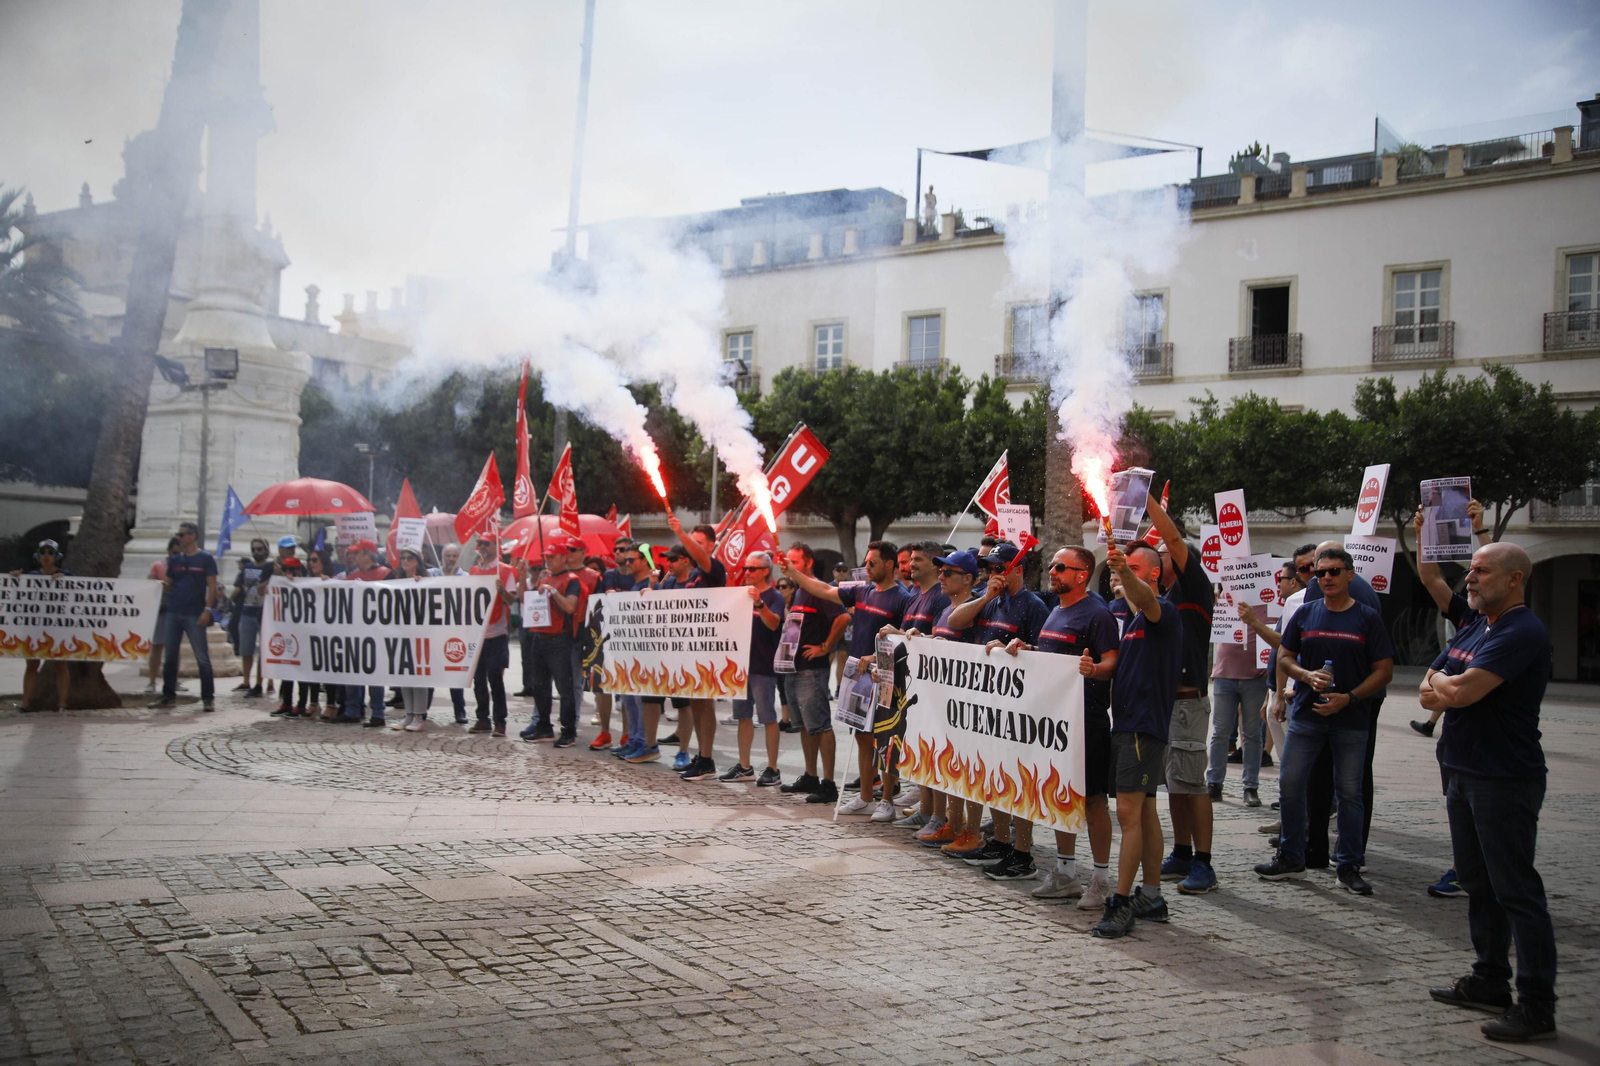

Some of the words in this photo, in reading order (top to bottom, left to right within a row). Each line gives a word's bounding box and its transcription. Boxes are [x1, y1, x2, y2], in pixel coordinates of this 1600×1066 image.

[1366, 482, 1377, 490] UEA
[1222, 506, 1236, 515] UEA
[1359, 509, 1374, 519] UEMA
[1220, 520, 1242, 528] ALMERIA
[1224, 532, 1242, 542] UEMA
[1346, 543, 1388, 553] NEGOCIACIÓN
[1236, 562, 1258, 570] UNAS
[1221, 570, 1272, 582] INSTALACIONES
[0, 577, 20, 587] IN
[26, 578, 115, 591] INVERSIÓN
[1230, 583, 1255, 591] DIGNAS
[16, 591, 70, 602] PUEDE
[74, 594, 106, 604] DAR
[113, 595, 135, 604] UN
[45, 605, 66, 614] DE
[70, 606, 140, 617] CALIDAD
[324, 588, 353, 624] UN
[362, 587, 492, 626] CONVENIO
[619, 601, 631, 611] LAS
[633, 599, 708, 611] INSTALACIONES
[13, 616, 108, 628] CIUDADANO
[609, 615, 621, 624] DEL
[622, 614, 653, 624] PARQUE
[656, 614, 668, 624] DE
[670, 612, 729, 624] BOMBEROS
[613, 628, 626, 638] SON
[628, 628, 638, 638] LA
[639, 626, 694, 637] VERGÜENZA
[697, 627, 717, 637] DEL
[446, 642, 464, 652] UGT
[608, 642, 668, 651] AYUNTAMIENTO
[672, 641, 684, 651] DE
[687, 639, 738, 651] ALMERÍA
[310, 636, 376, 674] DIGNO
[384, 638, 431, 676] YA!!
[916, 654, 1025, 699] BOMBEROS
[947, 699, 1069, 752] QUEMADOS
